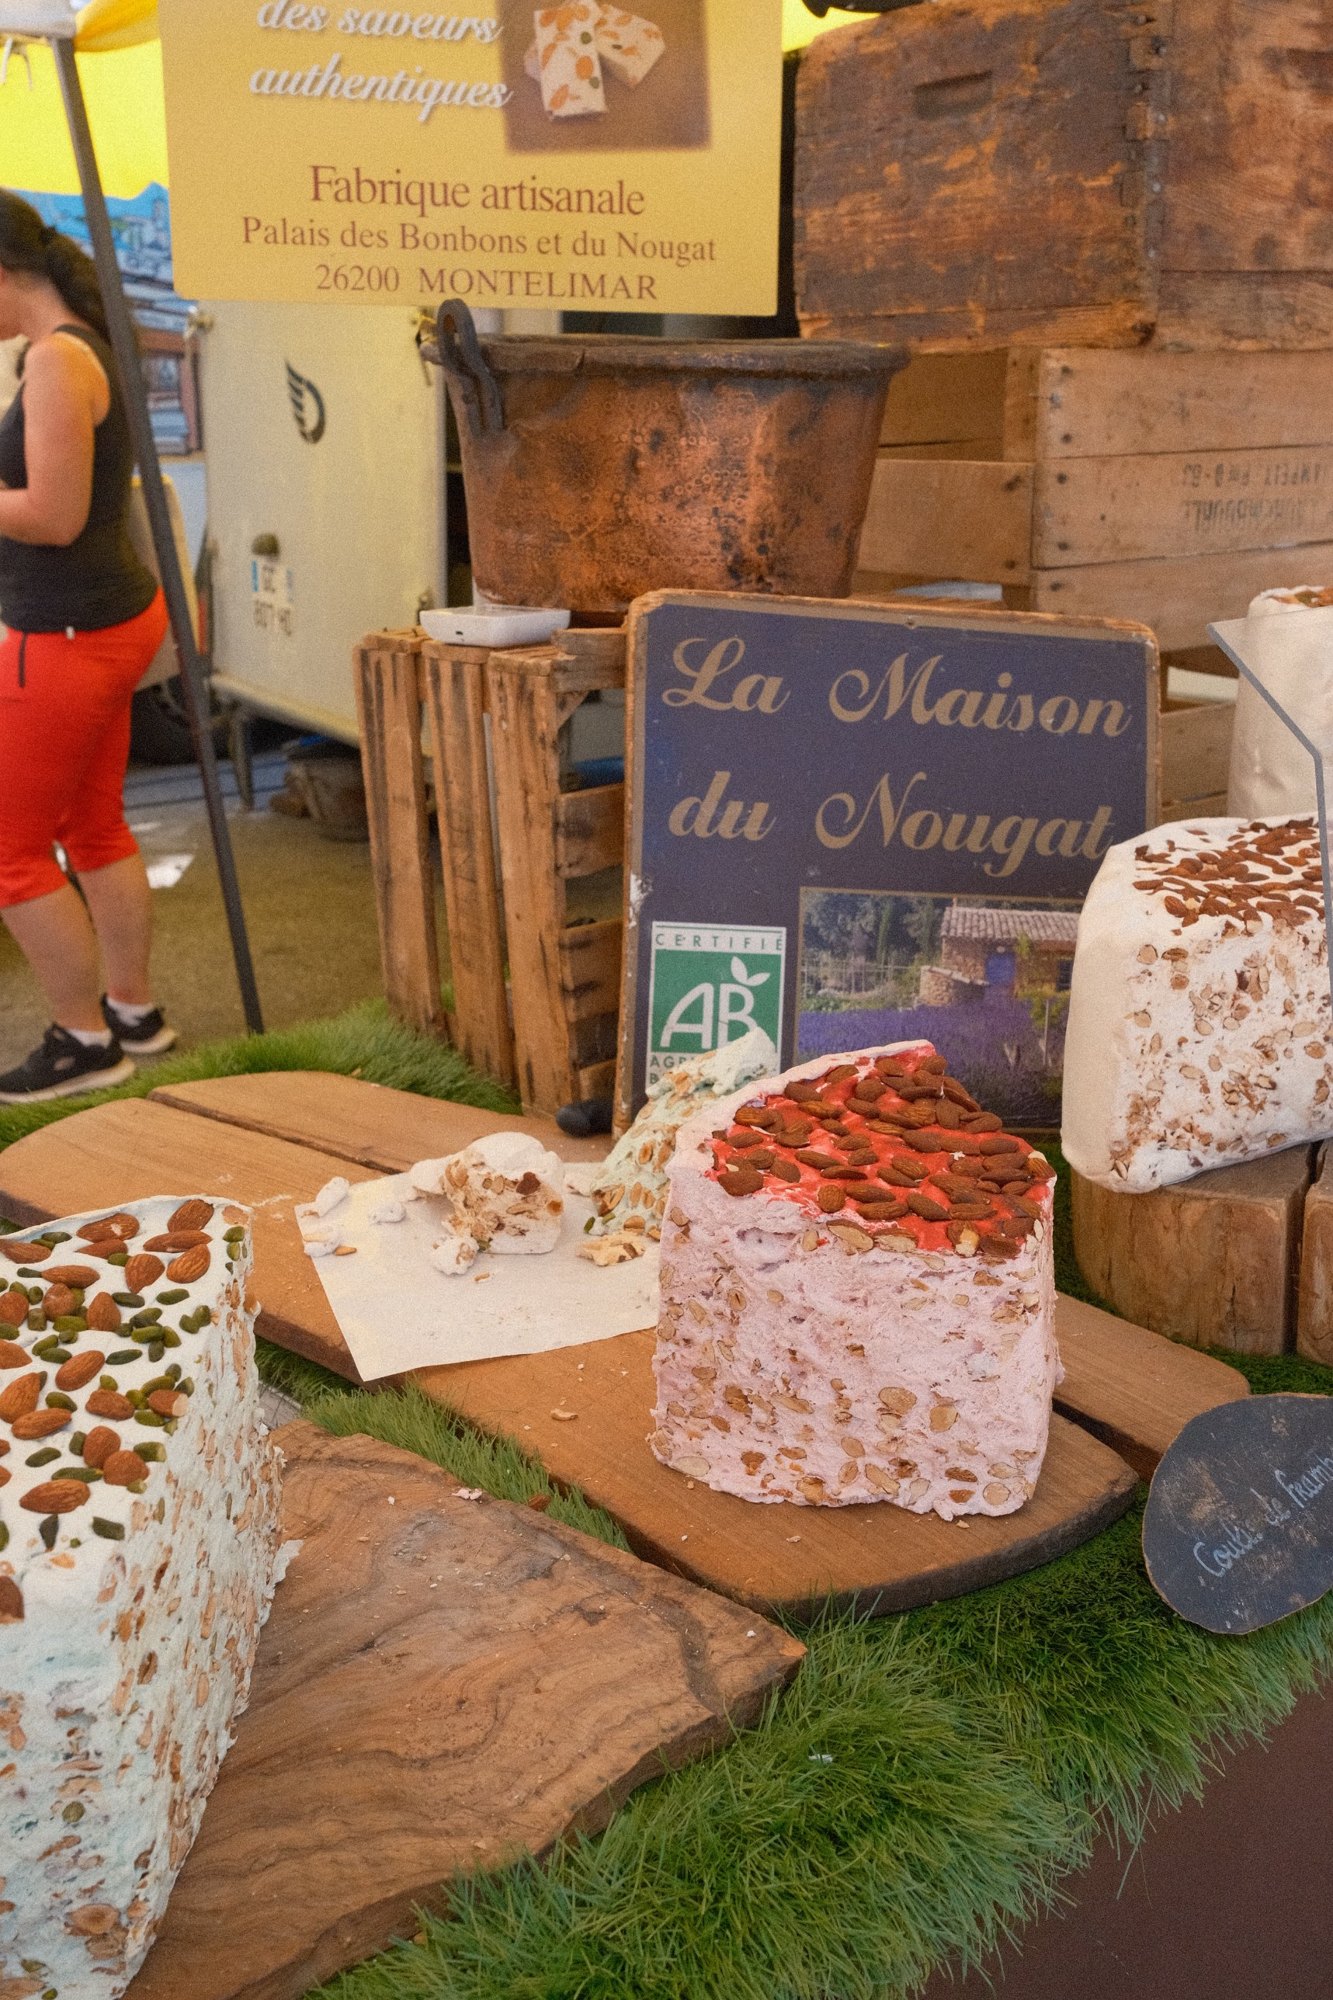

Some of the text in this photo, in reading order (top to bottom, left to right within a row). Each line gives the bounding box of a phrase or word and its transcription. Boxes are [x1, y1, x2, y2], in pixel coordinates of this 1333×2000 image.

[256, 0, 503, 43] des saveurs
[249, 52, 514, 123] authentiques
[311, 165, 645, 218] Fabrique artisanale
[243, 216, 715, 268] Palais des Bonbons et du Nougat
[316, 264, 658, 299] 26200 MONTELIMAR
[662, 636, 1132, 737] La Maison
[668, 770, 1115, 877] du Nougat
[659, 982, 758, 1050] AB
